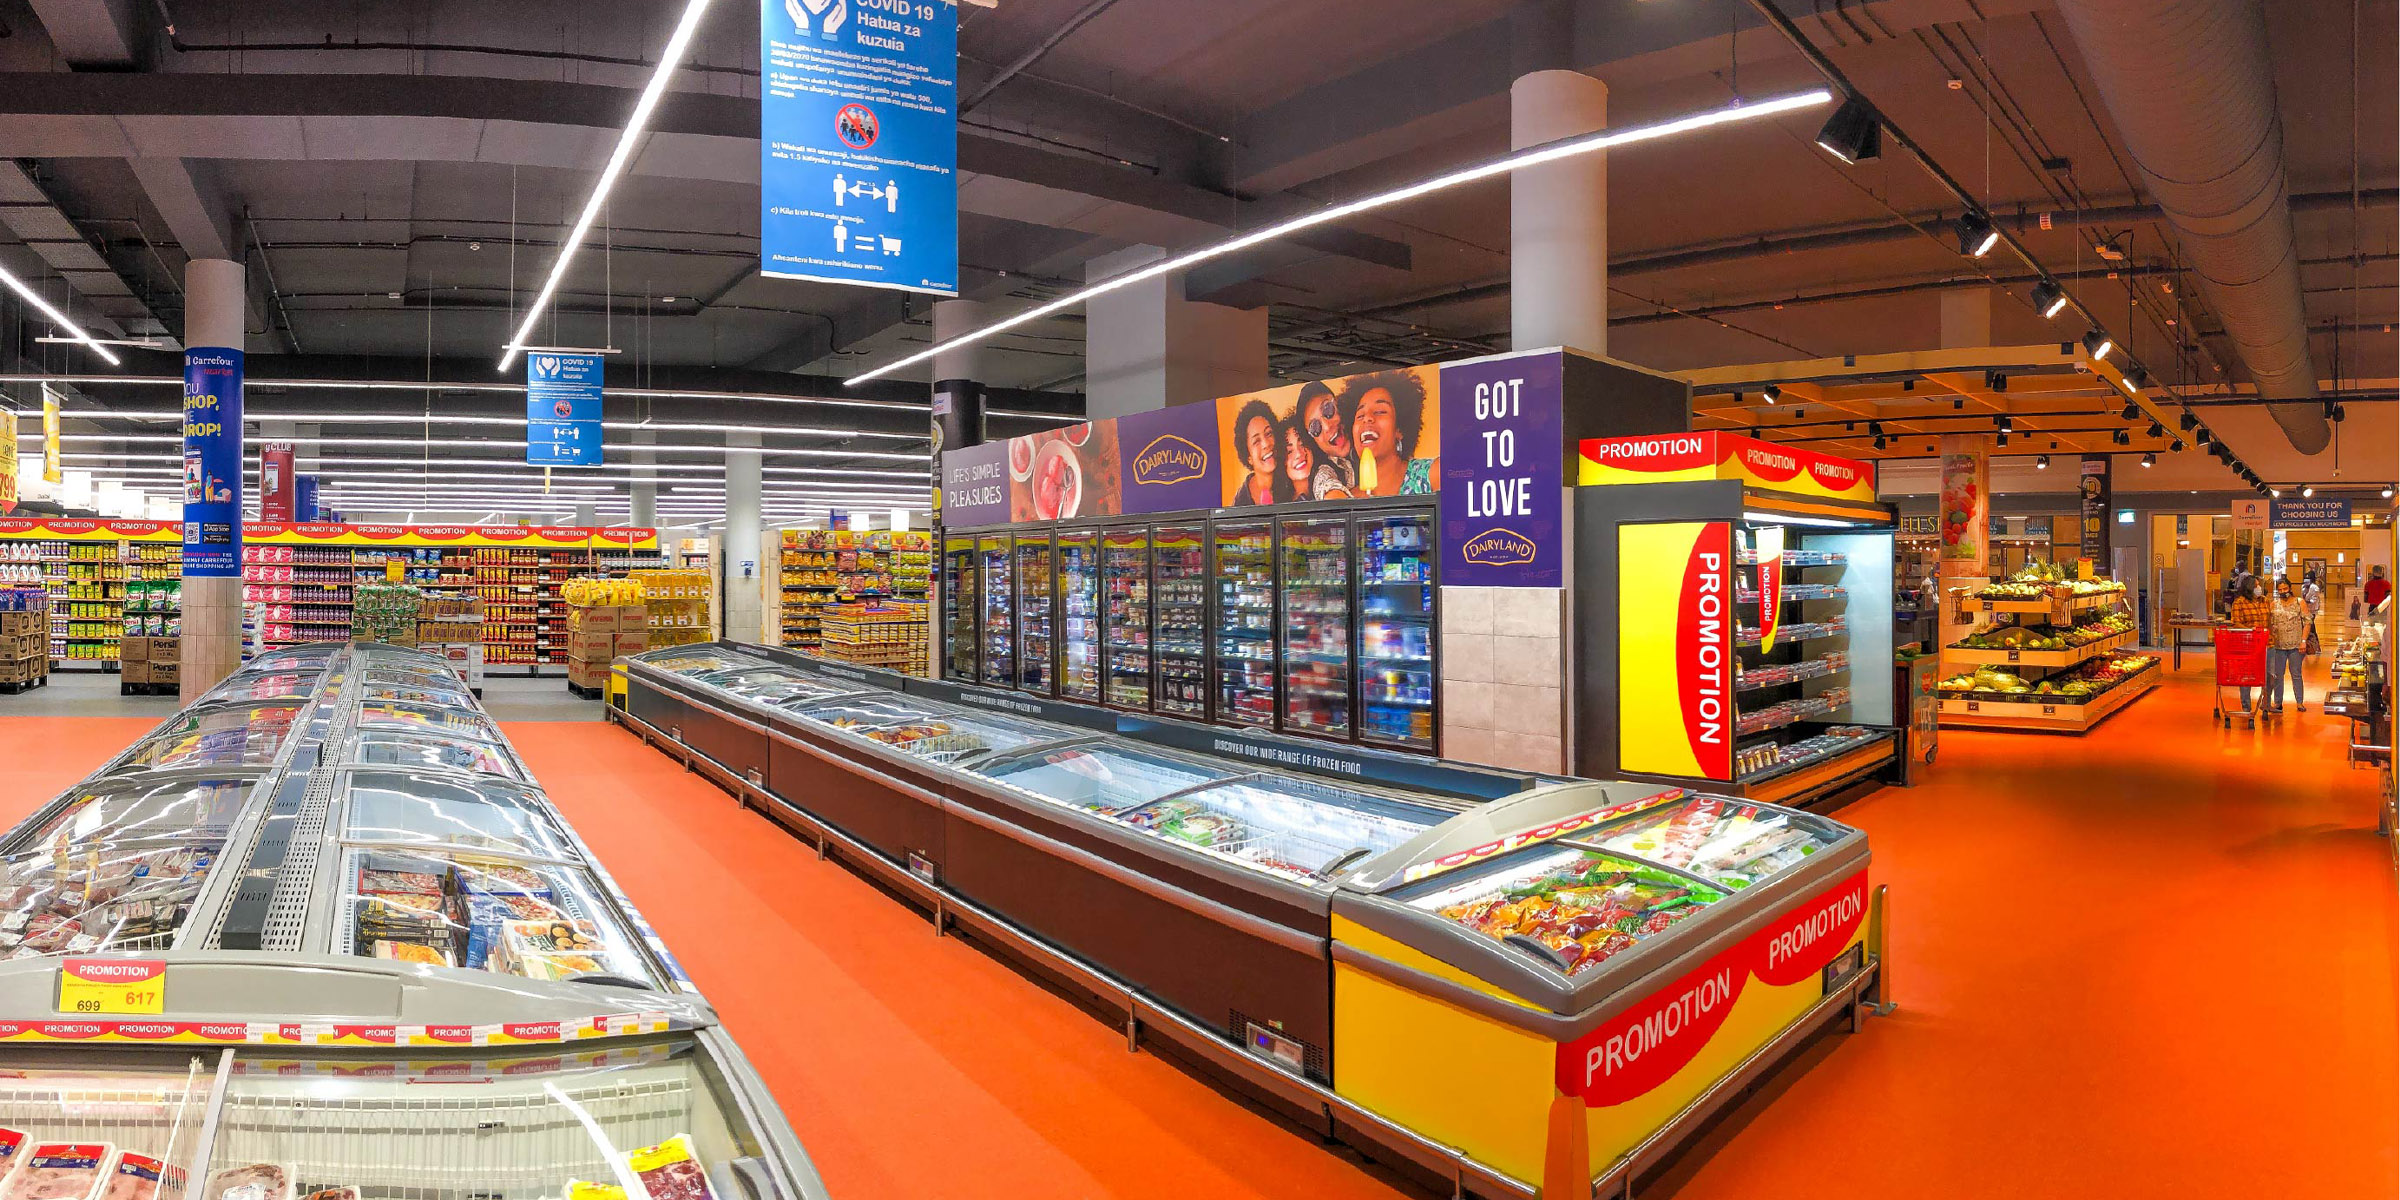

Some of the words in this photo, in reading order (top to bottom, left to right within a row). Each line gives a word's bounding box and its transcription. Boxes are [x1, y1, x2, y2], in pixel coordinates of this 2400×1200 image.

[856, 0, 910, 16] COVID
[914, 5, 934, 21] 19
[857, 11, 901, 33] Hatua
[903, 24, 921, 37] za
[857, 31, 905, 51] kuzuia
[770, 206, 778, 215] c)
[780, 207, 794, 215] Kila
[192, 356, 234, 367] Carrefour
[1474, 378, 1524, 421] GOT
[1482, 429, 1515, 468] TO
[1599, 437, 1702, 459] PROMOTION
[1138, 449, 1203, 476] DAIRYLAND
[1747, 448, 1796, 471] PROMOTION
[949, 466, 971, 484] LIFE'S
[971, 461, 1001, 481] SIMPLE
[1814, 461, 1854, 481] PROMOTION
[949, 485, 1002, 509] PLEASURES
[1467, 477, 1532, 517] LOVE
[48, 521, 95, 529] PROMOTION
[110, 522, 158, 530] PROMOTION
[297, 525, 343, 533] PROMOTION
[357, 526, 403, 534] PROMOTION
[418, 527, 466, 535] PROMOTION
[481, 528, 528, 536] PROMOTION
[541, 529, 588, 537] PROMOTION
[603, 529, 649, 537] PROMOION
[2084, 517, 2100, 533] 10
[1469, 539, 1532, 558] DAIRYLAND
[1763, 566, 1773, 622] PROMOTION
[153, 640, 177, 648] Persil
[1699, 552, 1721, 744] PROMOTION
[153, 663, 177, 671] Persil
[1214, 739, 1244, 755] DISCOVER
[1245, 744, 1259, 757] OUR
[1259, 746, 1277, 760] WIDE
[1277, 750, 1300, 764] RANGE
[1302, 753, 1311, 766] OF
[1313, 756, 1340, 772] FROZEN
[1341, 762, 1361, 775] FOOD
[1768, 887, 1861, 970] PROMOTION
[79, 965, 149, 977] PROMOTION
[77, 1000, 101, 1011] 699
[125, 992, 155, 1005] 617
[45, 1025, 100, 1033] PROMOTION
[120, 1025, 175, 1034] PROMOTION
[201, 1026, 247, 1035] PROMOTIO
[365, 1028, 396, 1038] PROMO
[434, 1028, 472, 1037] PROMOT
[514, 1025, 561, 1036] PROMOTIO
[1586, 967, 1730, 1088] PROMOTION
